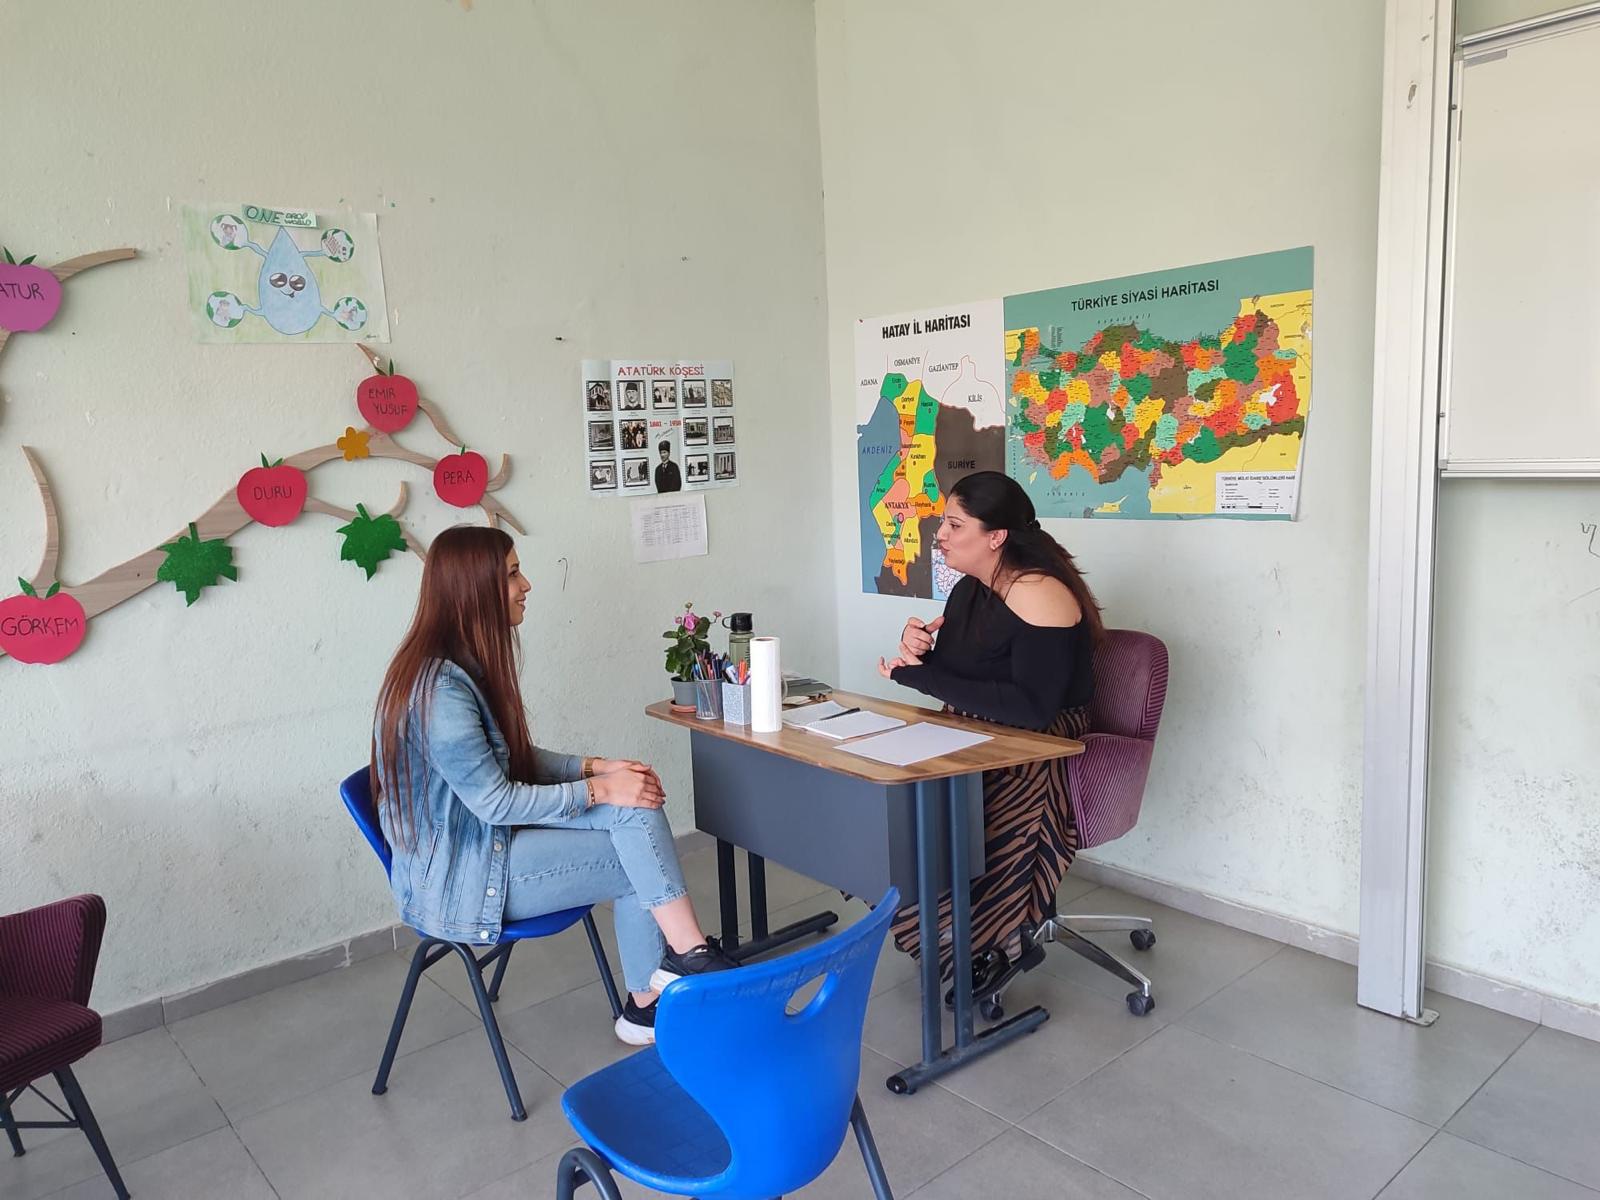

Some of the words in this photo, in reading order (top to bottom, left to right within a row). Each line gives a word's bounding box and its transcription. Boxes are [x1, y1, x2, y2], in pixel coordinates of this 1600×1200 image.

[246, 206, 284, 223] ONE
[1071, 294, 1118, 312] TÜRKİYE
[1121, 286, 1158, 305] SİYASİ
[1161, 279, 1219, 299] HARİTASI
[882, 322, 911, 340] HATAY
[913, 319, 922, 335] İL
[925, 314, 971, 333] HARİTASI
[617, 363, 666, 376] ATATÜRK
[669, 363, 705, 378] KÖŞESİ
[928, 362, 959, 373] GAZİANTEP
[860, 378, 878, 387] ADANA
[372, 403, 408, 416] YUSUF
[947, 460, 977, 470] SURİYE
[443, 471, 476, 486] PERA
[253, 486, 293, 501] DURU
[1, 614, 80, 637] GÖRKEM
